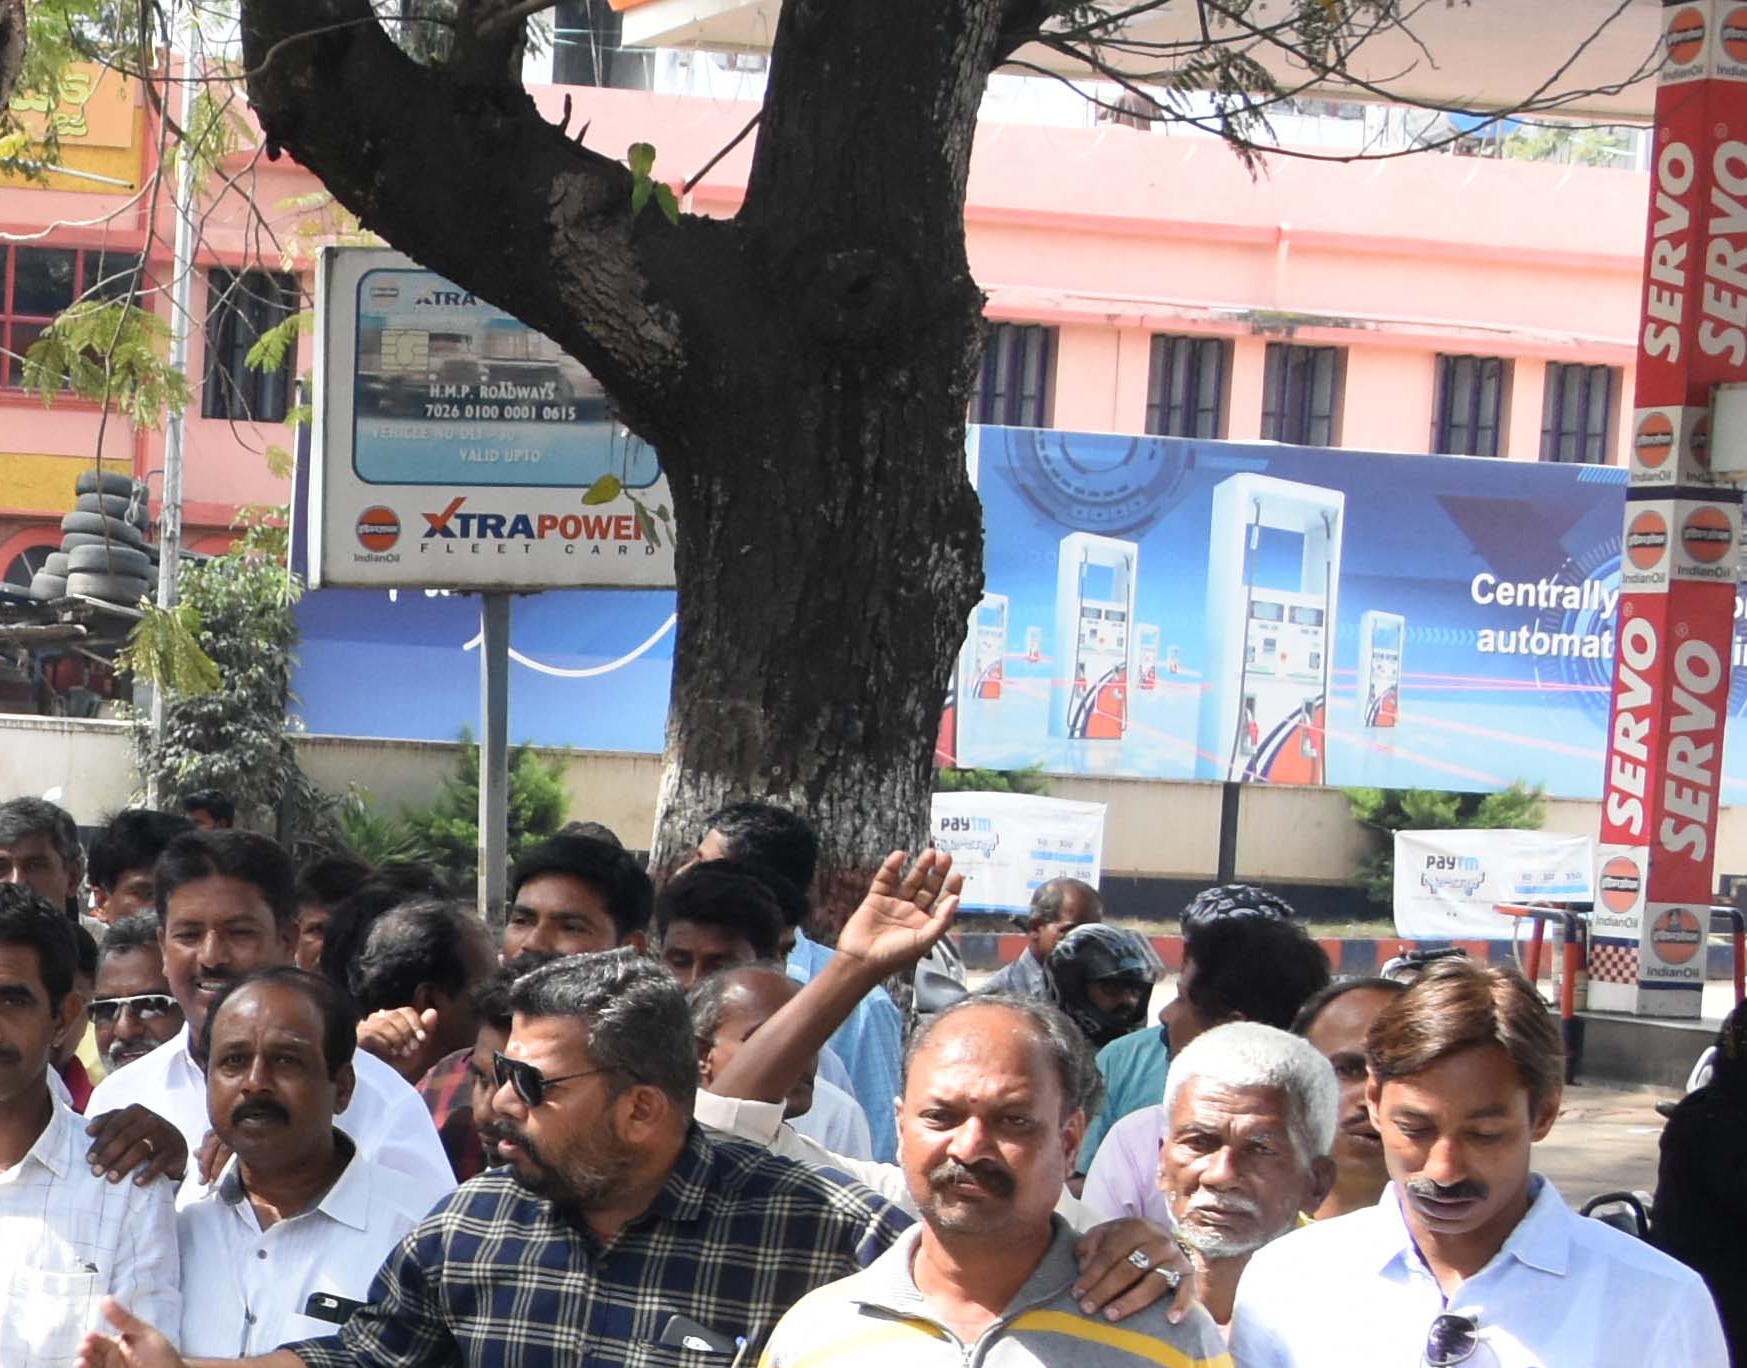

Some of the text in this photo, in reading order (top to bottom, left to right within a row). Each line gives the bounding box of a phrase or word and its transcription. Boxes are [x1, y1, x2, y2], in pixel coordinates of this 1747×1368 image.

[1643, 141, 1695, 364] SERVO
[1698, 140, 1747, 367] SERVO
[429, 382, 556, 401] H.M.P. ROADWAYS
[425, 403, 577, 421] 7026 0100 0001 0615
[459, 449, 541, 464] VALID UPTO
[419, 542, 656, 556] FLEET CARD
[353, 553, 401, 564] IndianOil
[1622, 572, 1666, 584] IndianOil
[1677, 565, 1731, 579] IndianOil
[1470, 572, 1619, 621] Centrally
[1476, 623, 1615, 659] automat
[1607, 617, 1658, 837] SERVO
[1659, 639, 1721, 863] SERVO
[1595, 915, 1639, 929] IndianOil
[1646, 966, 1700, 979] IndianOil
